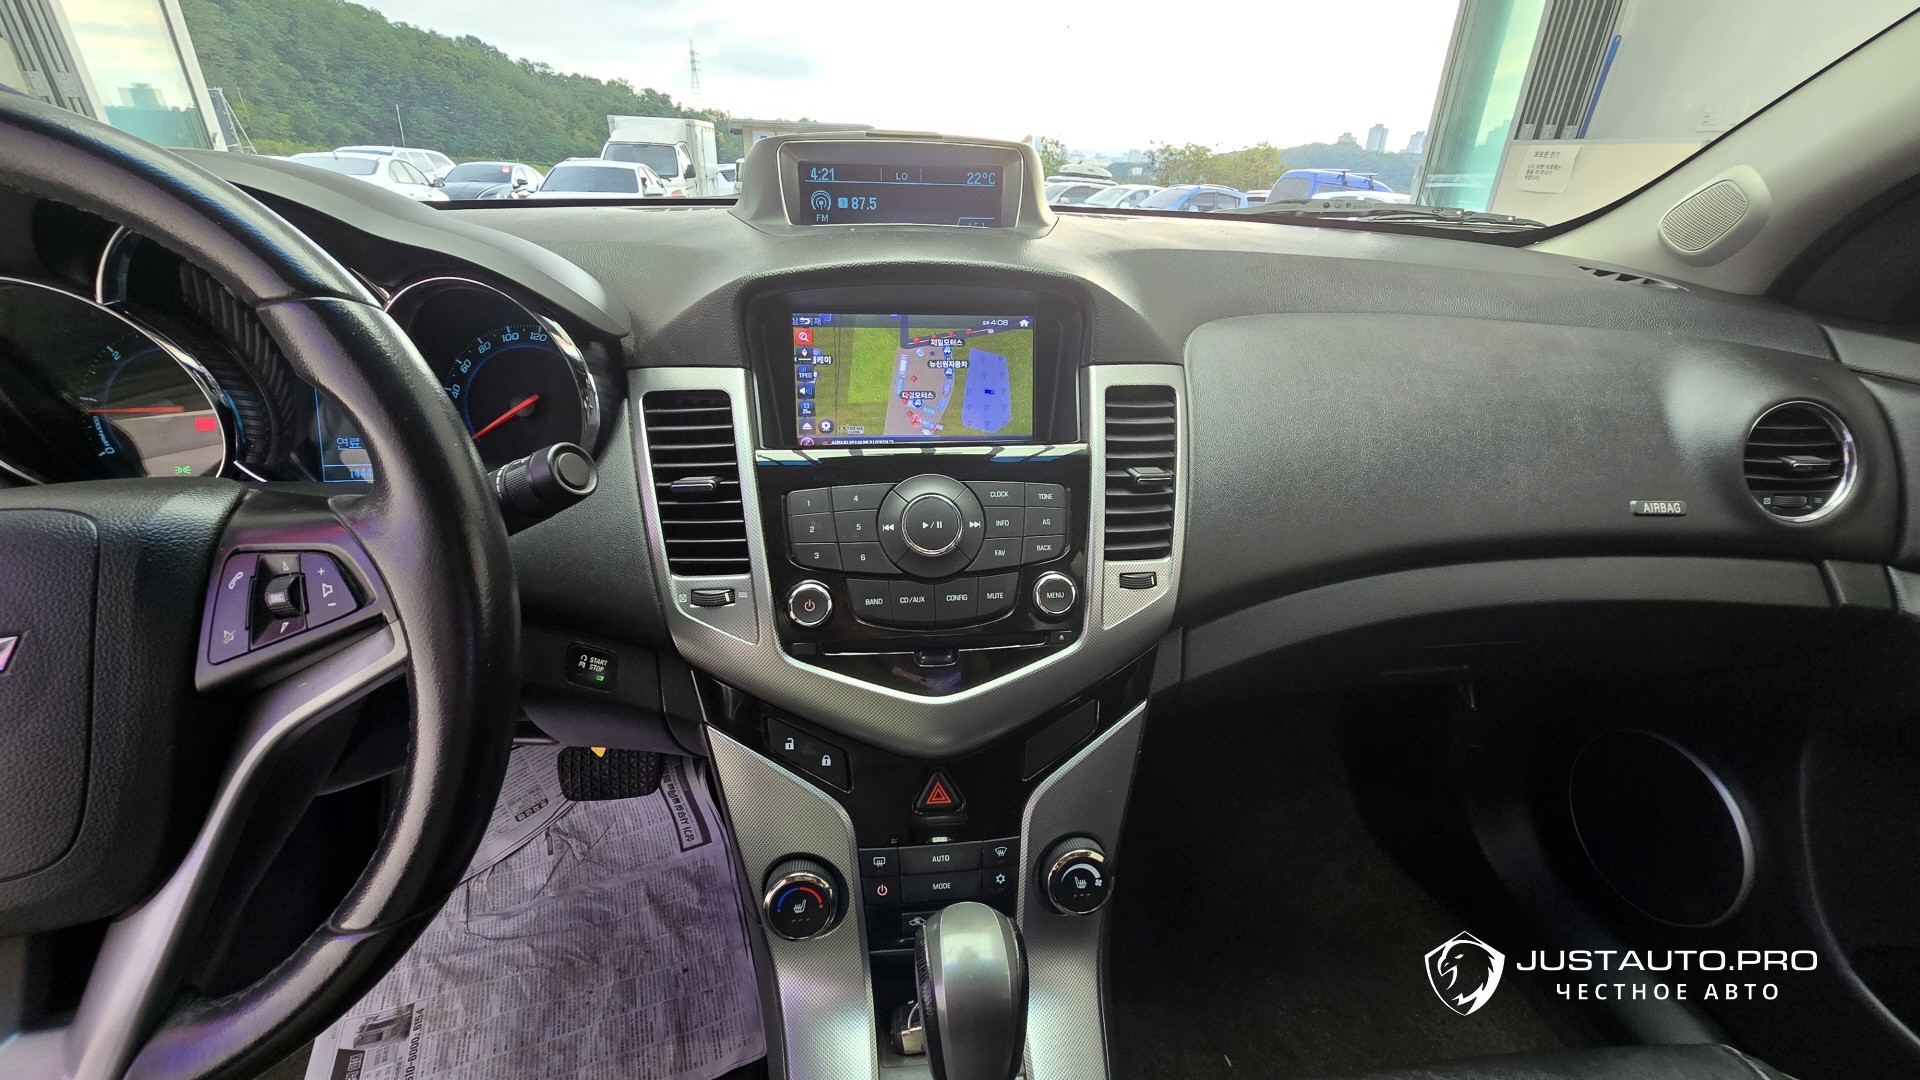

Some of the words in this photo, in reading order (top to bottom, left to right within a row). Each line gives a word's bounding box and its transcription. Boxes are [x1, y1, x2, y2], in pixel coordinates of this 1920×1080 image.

[810, 167, 835, 181] 4:21
[896, 172, 908, 180] LO
[966, 171, 996, 185] 22°C
[851, 196, 877, 210] 87.5
[816, 214, 829, 222] FM
[501, 332, 520, 342] 100
[530, 332, 548, 342] 120
[478, 341, 491, 354] 80
[460, 359, 472, 374] 60
[451, 384, 461, 399] 40
[336, 437, 362, 450] 연료
[104, 446, 115, 455] 0
[990, 490, 1009, 498] CLOCK
[1643, 502, 1682, 514] AIRBAG
[1036, 544, 1052, 552] BACK
[900, 596, 926, 604] CD/AUX
[946, 594, 968, 602] CONFIG
[986, 592, 1004, 600] MUTE
[1046, 592, 1065, 600] MENU
[865, 598, 884, 606] BAND
[589, 656, 608, 666] START
[588, 664, 604, 672] STOP
[932, 854, 950, 862] AUTO
[932, 882, 952, 890] MODE
